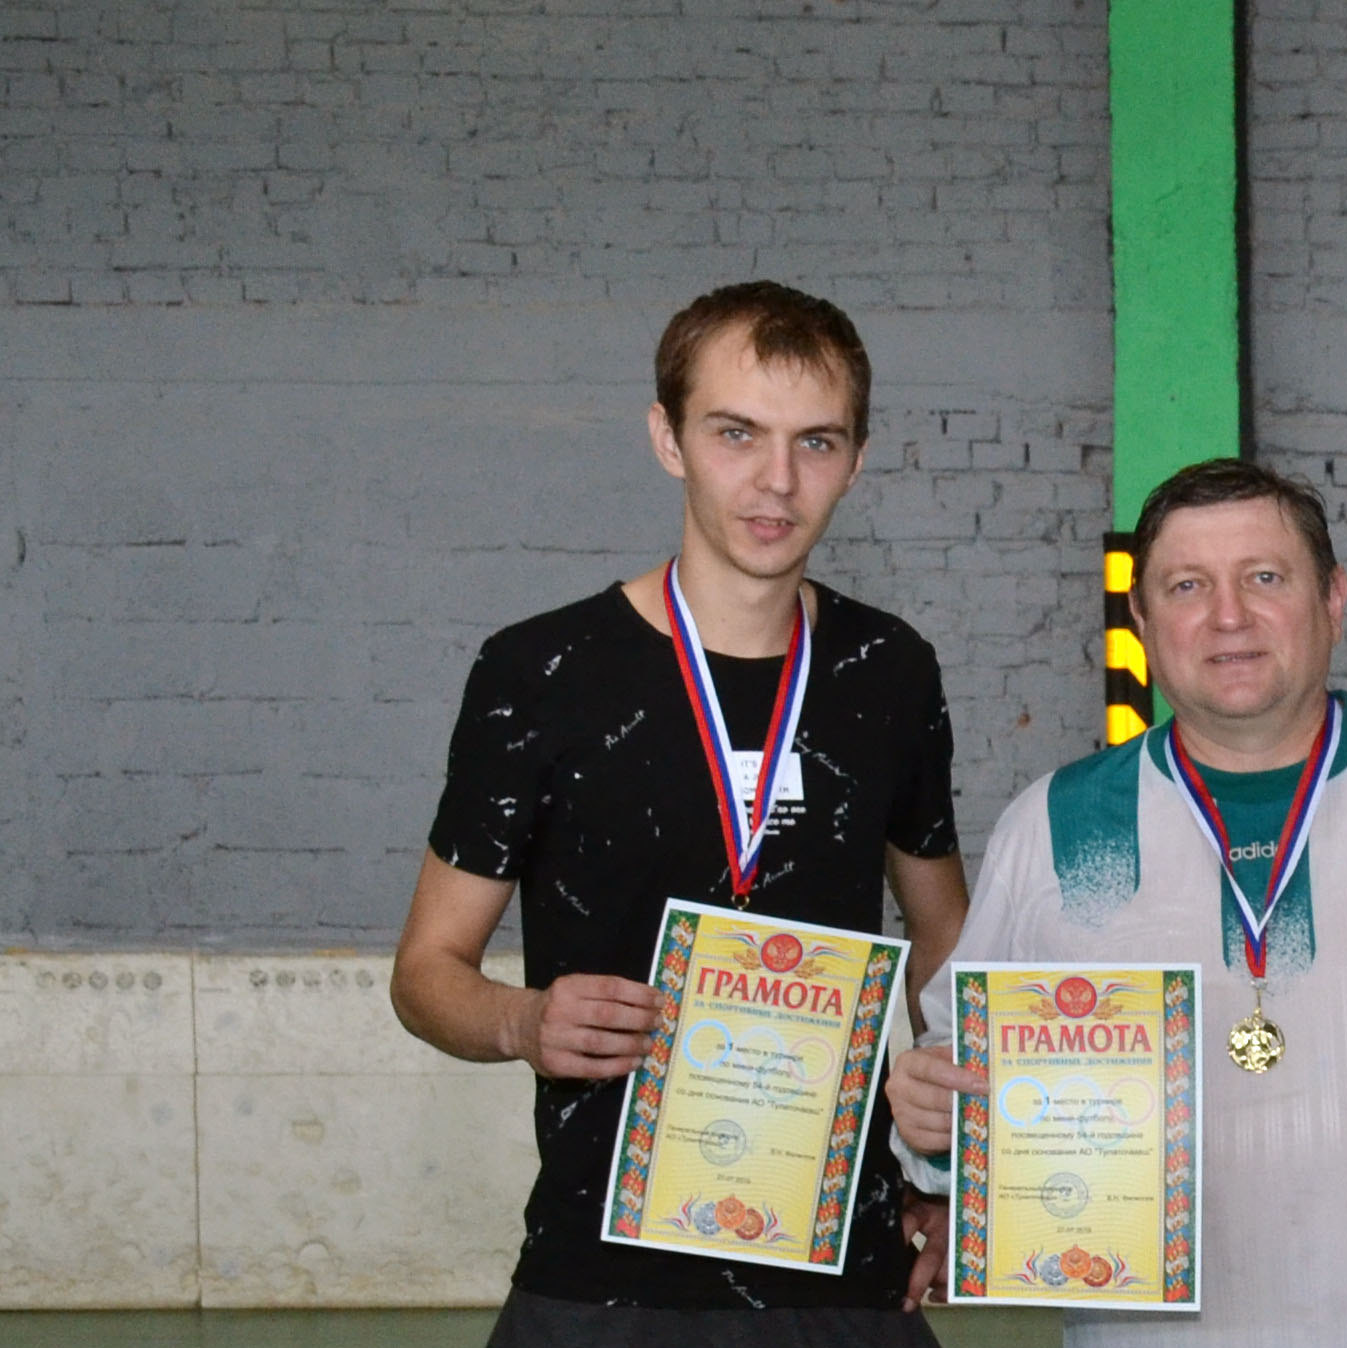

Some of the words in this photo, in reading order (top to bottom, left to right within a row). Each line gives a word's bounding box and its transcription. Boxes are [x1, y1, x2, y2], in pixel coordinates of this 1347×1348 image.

[1229, 840, 1278, 861] adid
[696, 967, 844, 1016] ГРАМОТА
[1001, 1023, 1152, 1052] ГРАМОТА
